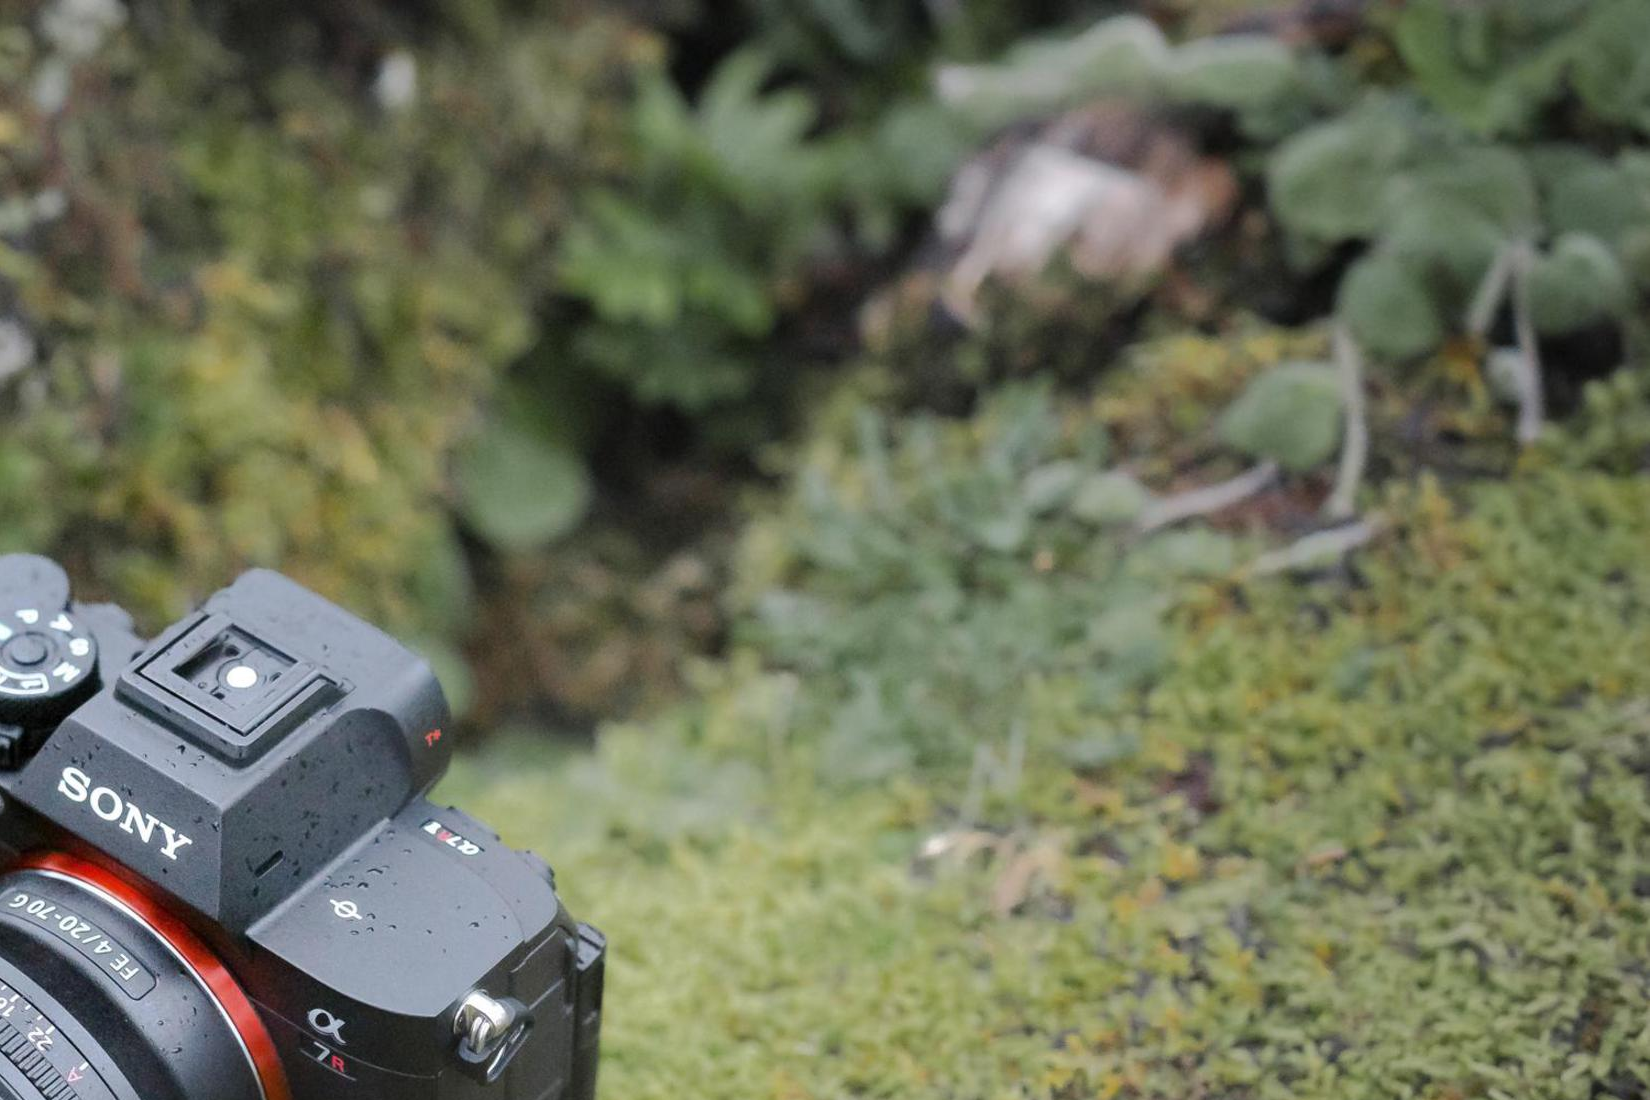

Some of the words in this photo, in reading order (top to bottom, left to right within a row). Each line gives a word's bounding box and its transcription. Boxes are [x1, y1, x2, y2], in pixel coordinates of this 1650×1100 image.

[57, 766, 193, 860] SONY
[109, 953, 140, 981] FE
[27, 1026, 54, 1051] 22
[313, 1041, 345, 1073] 7R
